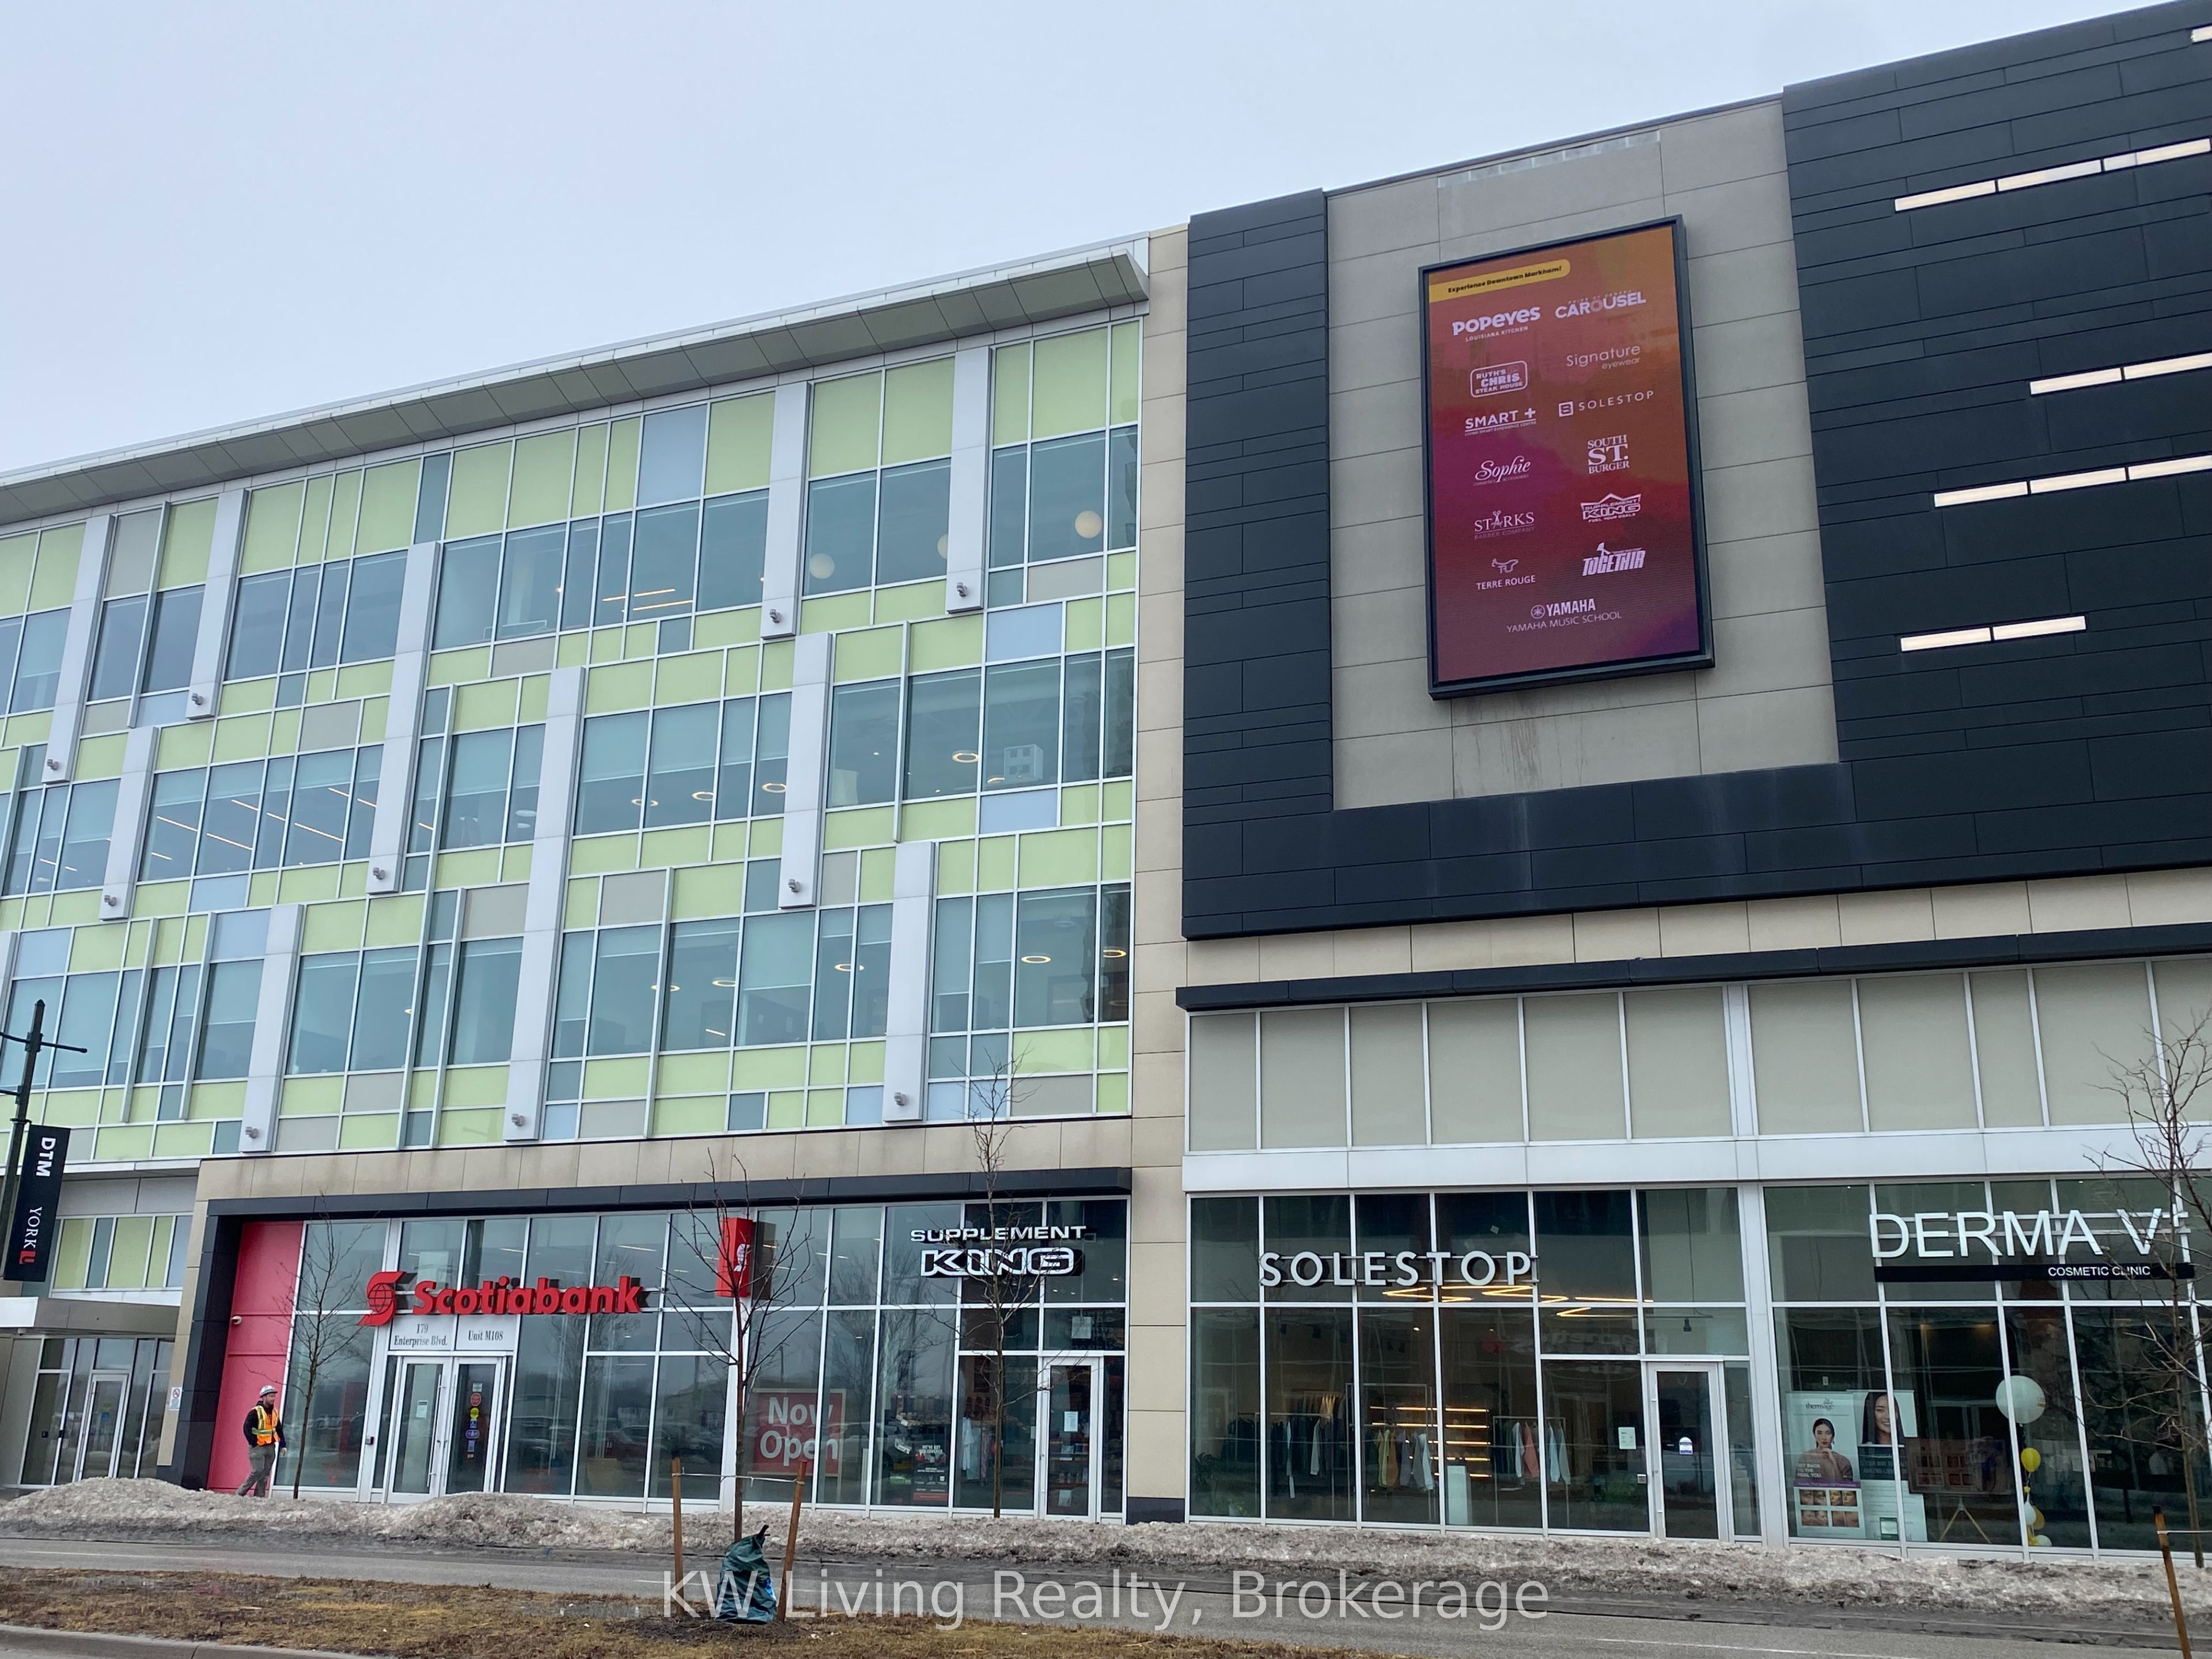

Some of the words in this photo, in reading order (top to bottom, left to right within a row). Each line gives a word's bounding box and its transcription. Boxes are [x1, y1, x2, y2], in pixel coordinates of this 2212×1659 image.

[1448, 282, 1486, 293] Experience
[1487, 274, 1524, 286] Downtown
[1525, 266, 1562, 278] Markham!
[1555, 291, 1646, 318] CAROUSEL
[1465, 331, 1500, 342] LOUISIANA
[1501, 325, 1528, 335] KITCHEN
[1566, 345, 1641, 367] Signature
[1601, 357, 1641, 370] eyewear
[1476, 369, 1506, 380] RUTH'S
[1481, 373, 1520, 388] CHRIS
[1475, 385, 1498, 395] STEAK
[1500, 381, 1524, 390] HOUSE
[1578, 390, 1654, 411] SOLESTOP
[1465, 410, 1519, 429] SMART
[1587, 434, 1628, 449] SOUTH
[1588, 443, 1629, 466] ST.
[1475, 455, 1531, 483] Sophie
[1588, 460, 1630, 474] BURGER
[1582, 503, 1641, 520] KING
[1585, 498, 1638, 510] SUPPLEMENT
[1475, 510, 1535, 532] STARKS
[1502, 527, 1535, 536] COMPANY
[1476, 579, 1503, 590] TERRE
[1505, 575, 1536, 586] ROUGE
[1546, 598, 1596, 617] YAMAHA
[1507, 620, 1547, 633] YAMAHA
[1550, 616, 1580, 627] MUSIC
[1582, 611, 1622, 623] SCHOOL
[36, 1137, 56, 1177] DTM
[910, 1225, 1086, 1242] SUPPLEMENT
[1869, 1210, 2104, 1258] DERMA
[921, 1247, 1075, 1277] KING
[1259, 1250, 1532, 1287] SOLESTOP
[2047, 1266, 2109, 1278] COSMETIC
[2111, 1266, 2151, 1277] CLINIC
[412, 1275, 643, 1315] Scotiabank
[416, 1323, 429, 1334] 179
[468, 1330, 483, 1341] Unit
[484, 1330, 504, 1341] M108
[394, 1335, 429, 1348] Enterprise
[430, 1335, 448, 1346] Blvd.
[760, 1430, 839, 1467] Open
